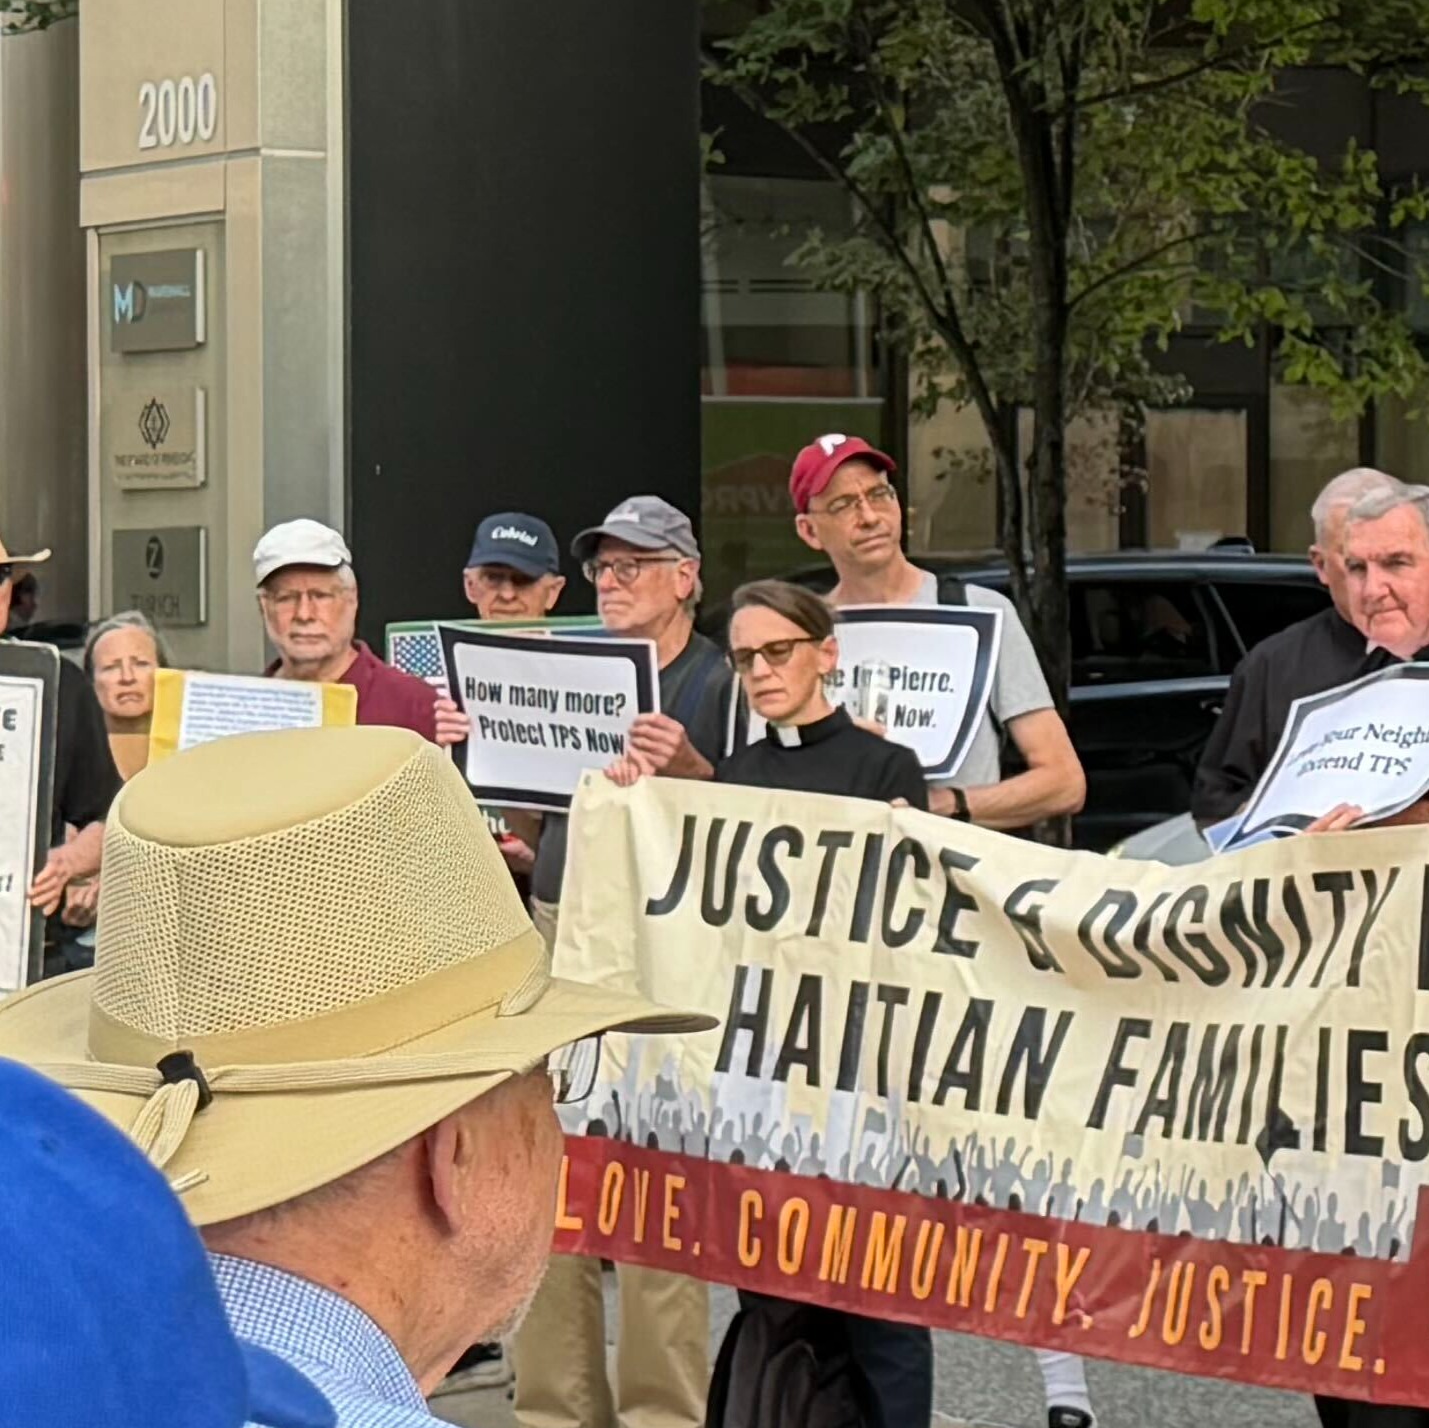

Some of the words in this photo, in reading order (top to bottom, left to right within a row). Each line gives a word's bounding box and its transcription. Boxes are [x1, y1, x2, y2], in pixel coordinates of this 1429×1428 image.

[138, 73, 217, 149] 2000
[465, 676, 502, 704] How
[509, 684, 559, 714] many
[565, 690, 626, 717] more?
[889, 665, 954, 693] Pierre.
[478, 715, 546, 747] Protect
[549, 724, 581, 750] TPS
[893, 704, 937, 728] Now.
[645, 814, 981, 959] JUSTICE
[1078, 865, 1400, 989] DIGNITY
[715, 965, 1074, 1120] HAITIAN
[555, 1156, 701, 1255] LOVE.
[738, 1189, 1093, 1330] COMMUNITY.
[1129, 1259, 1386, 1374] JUSTICE.
